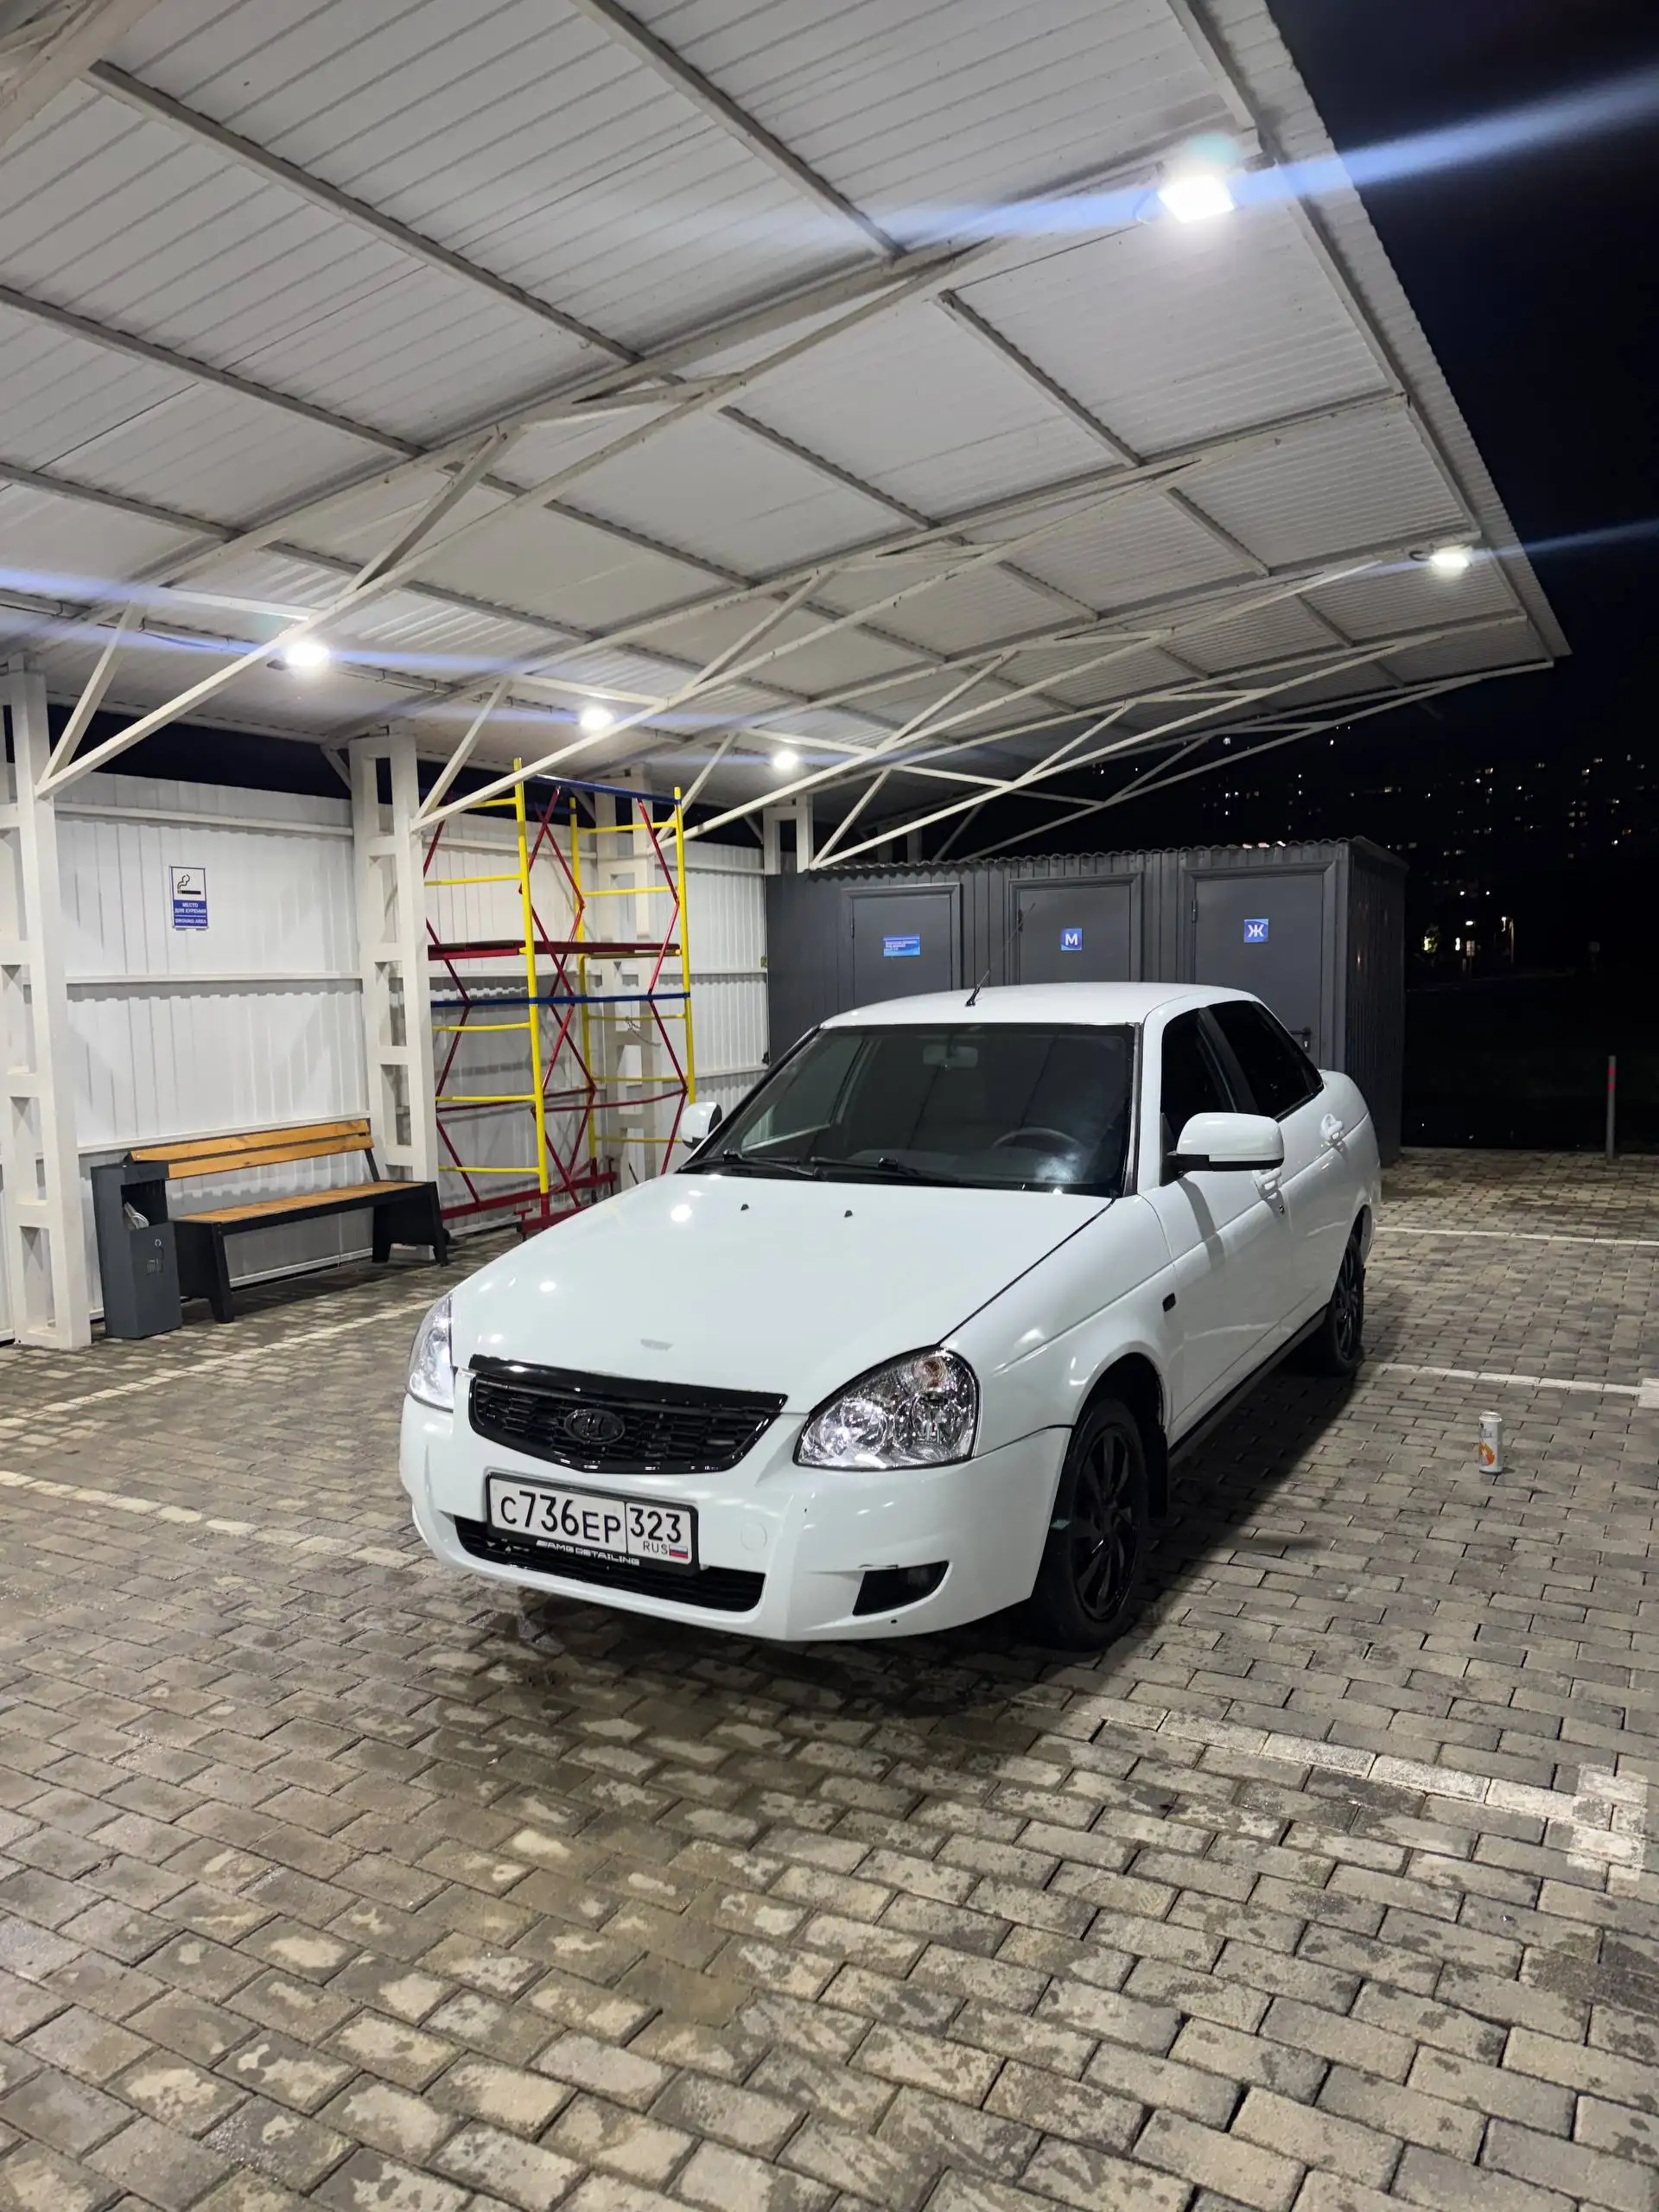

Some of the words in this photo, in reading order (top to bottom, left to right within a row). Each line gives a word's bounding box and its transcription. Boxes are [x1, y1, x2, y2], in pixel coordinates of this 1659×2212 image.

[1248, 924, 1264, 938] Ж
[1065, 933, 1077, 946] М
[500, 1490, 621, 1543] С736ЕР
[629, 1507, 682, 1544] 323
[642, 1541, 669, 1556] RUS
[575, 1547, 640, 1567] DETAILING
